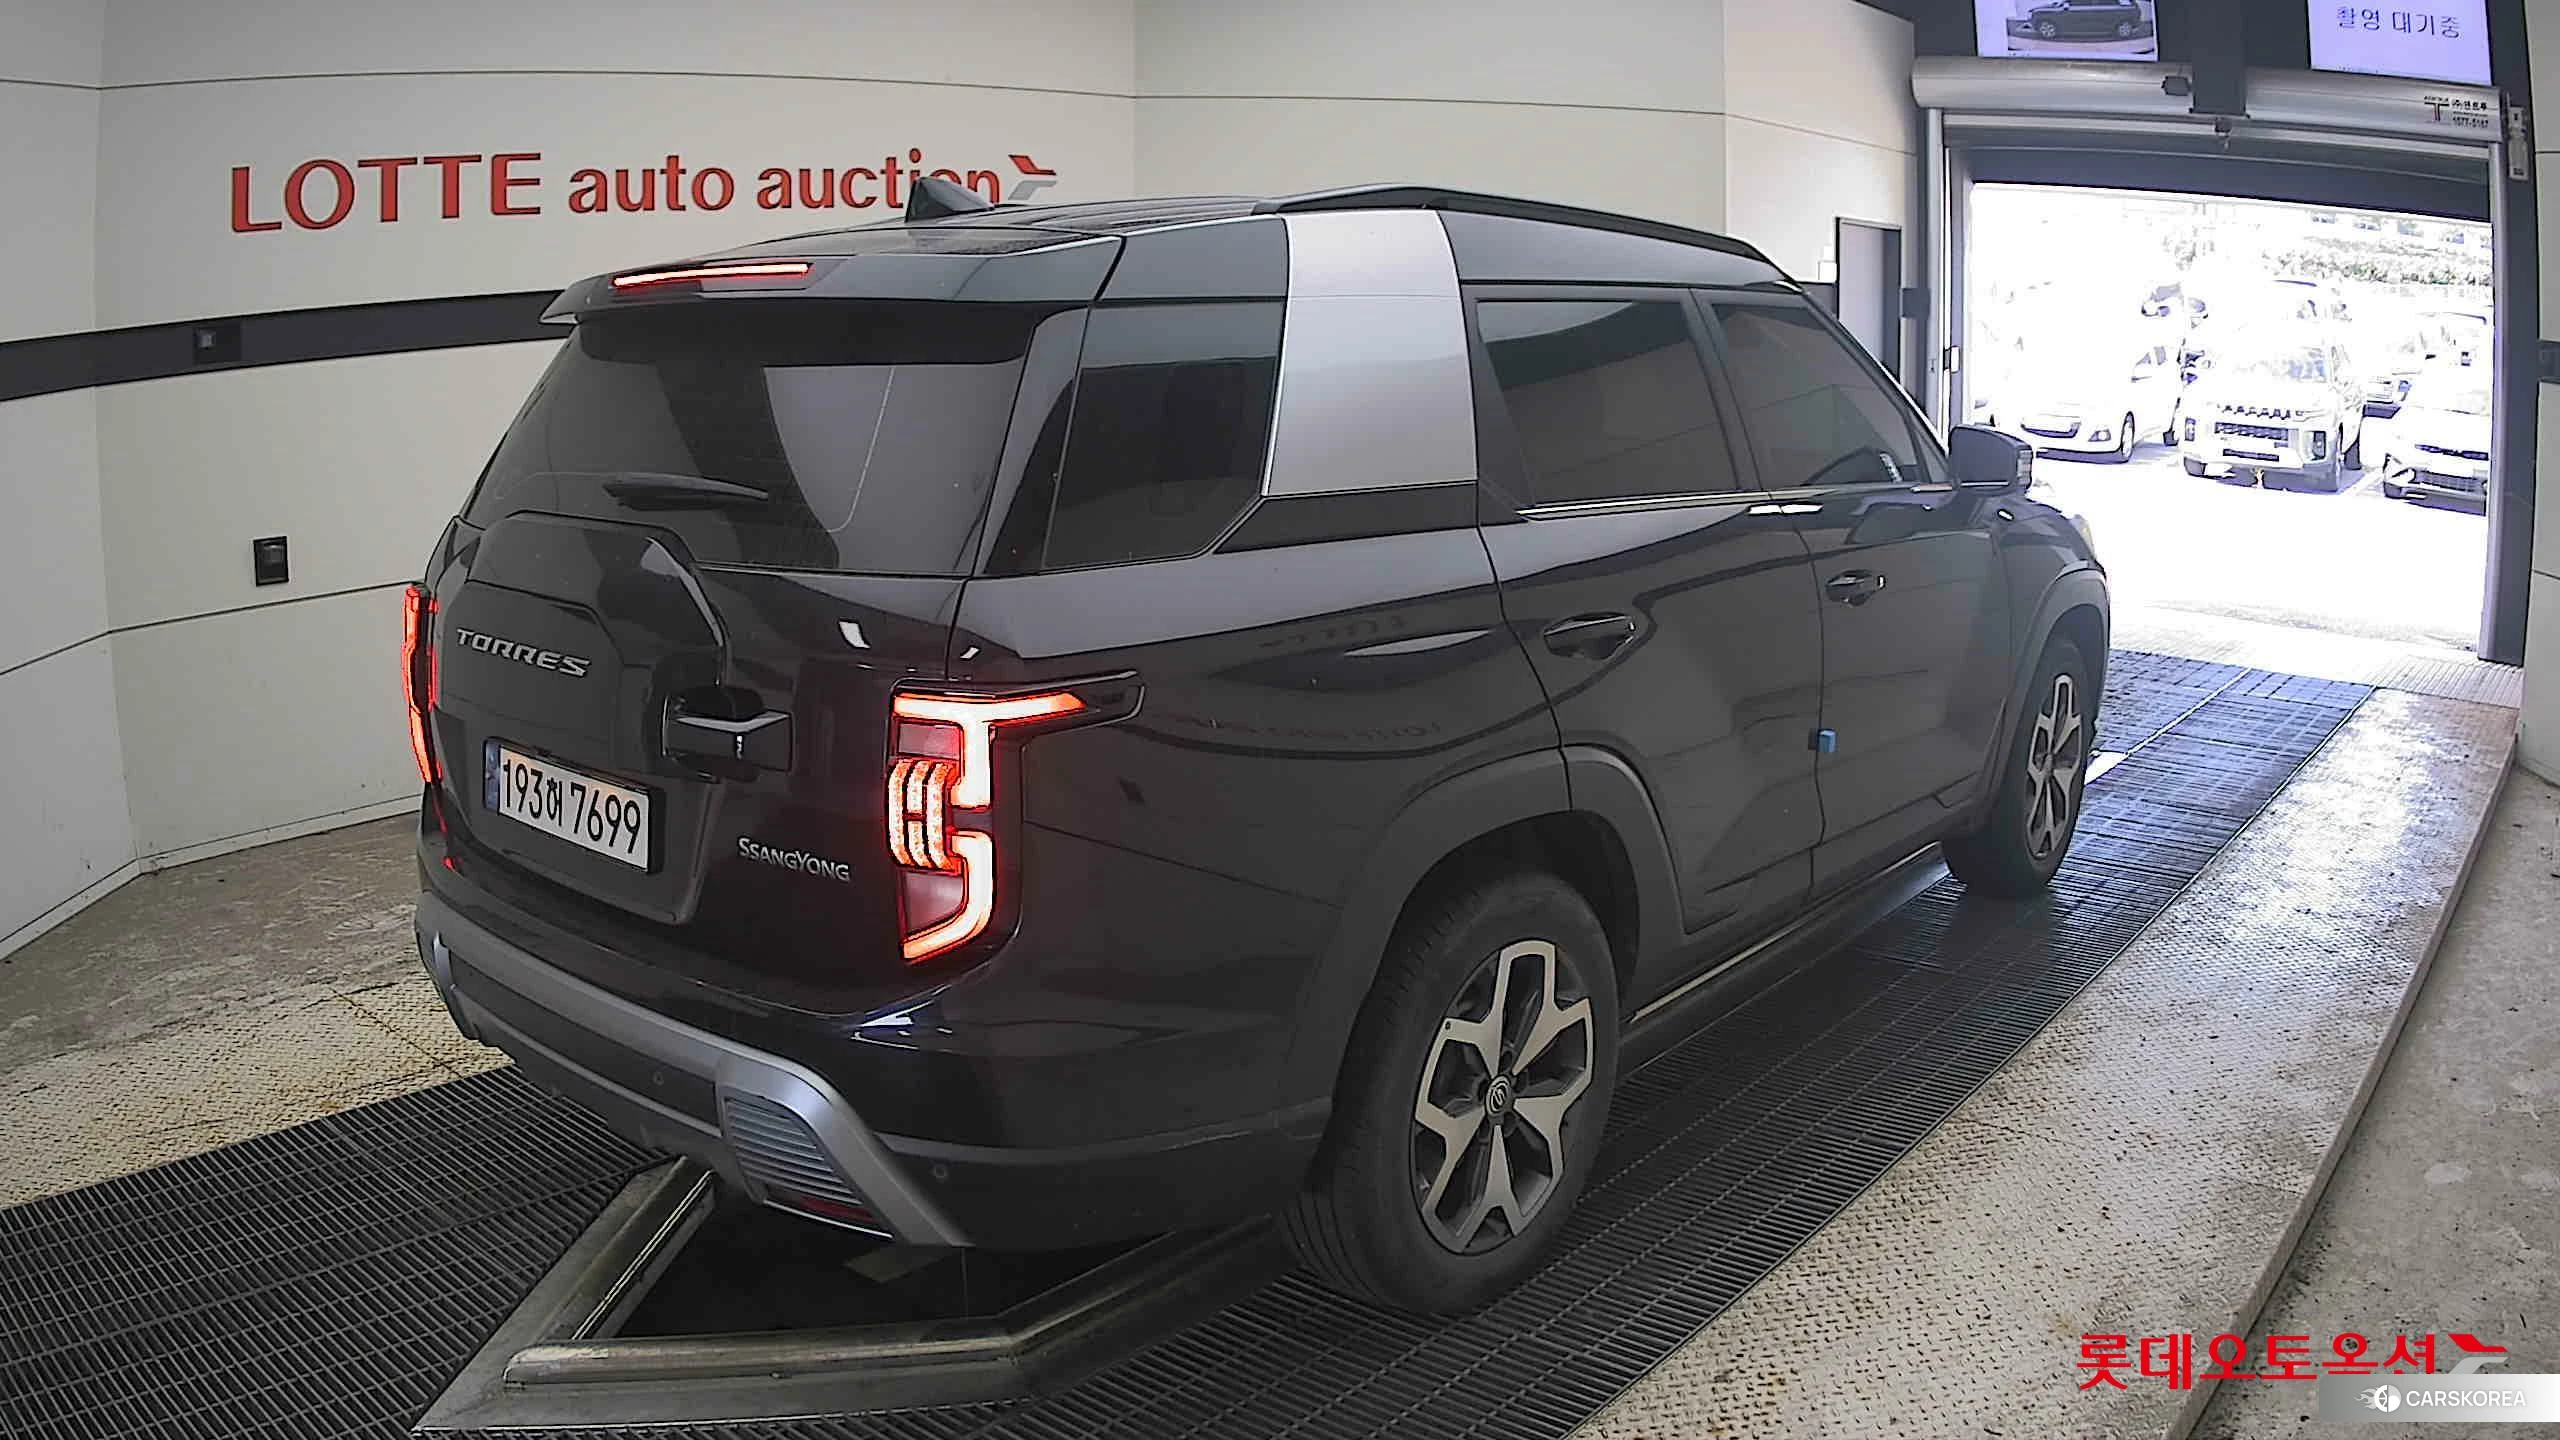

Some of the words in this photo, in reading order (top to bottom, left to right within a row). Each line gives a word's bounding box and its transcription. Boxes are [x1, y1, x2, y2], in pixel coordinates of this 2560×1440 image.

[2337, 6, 2380, 31] 촬영
[2392, 12, 2461, 39] 대기중
[231, 152, 542, 232] LOTTE
[568, 155, 735, 214] auto
[456, 628, 591, 677] TORRES
[503, 759, 562, 826] 193허
[571, 782, 641, 854] 7699
